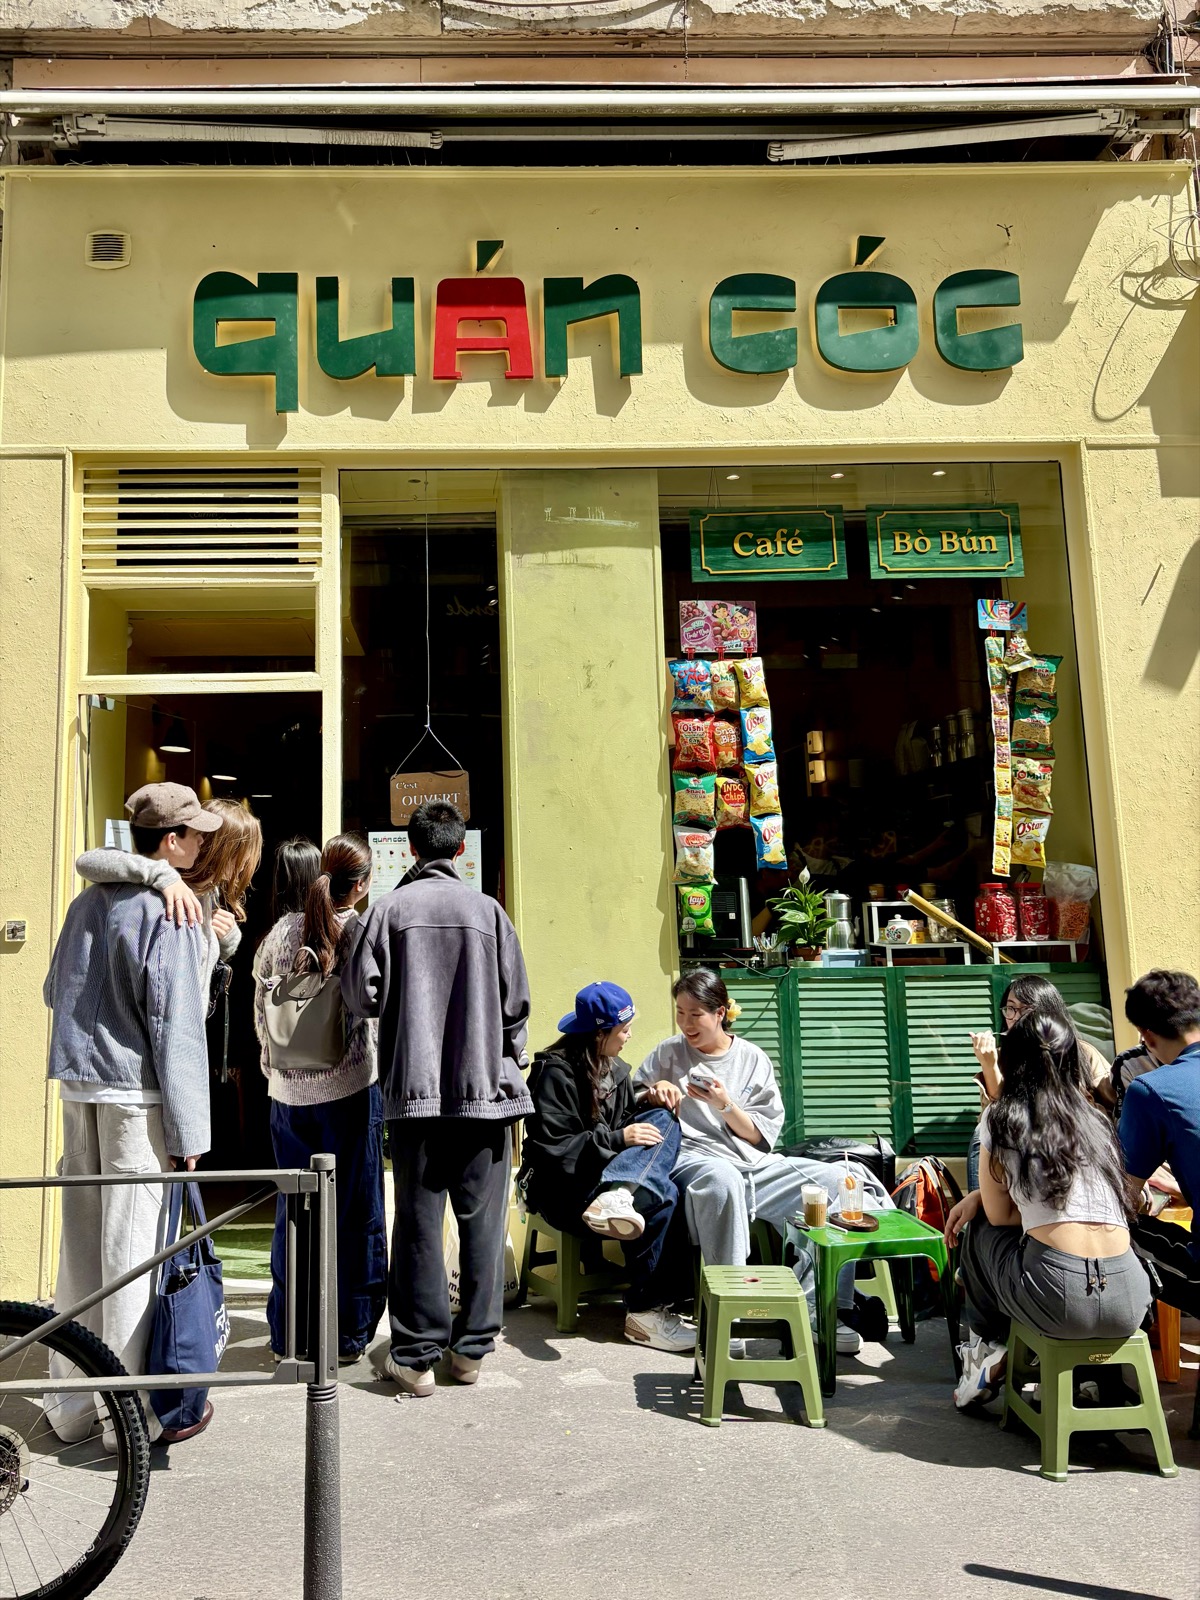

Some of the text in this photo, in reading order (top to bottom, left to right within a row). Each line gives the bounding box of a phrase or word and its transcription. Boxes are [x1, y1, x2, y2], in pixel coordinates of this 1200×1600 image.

[733, 528, 804, 557] Café
[892, 527, 999, 553] Bò Bún
[715, 726, 741, 735] Snac
[395, 782, 418, 790] C'est
[723, 783, 744, 792] INDO
[37, 1554, 87, 1597] ROCK RIDER
